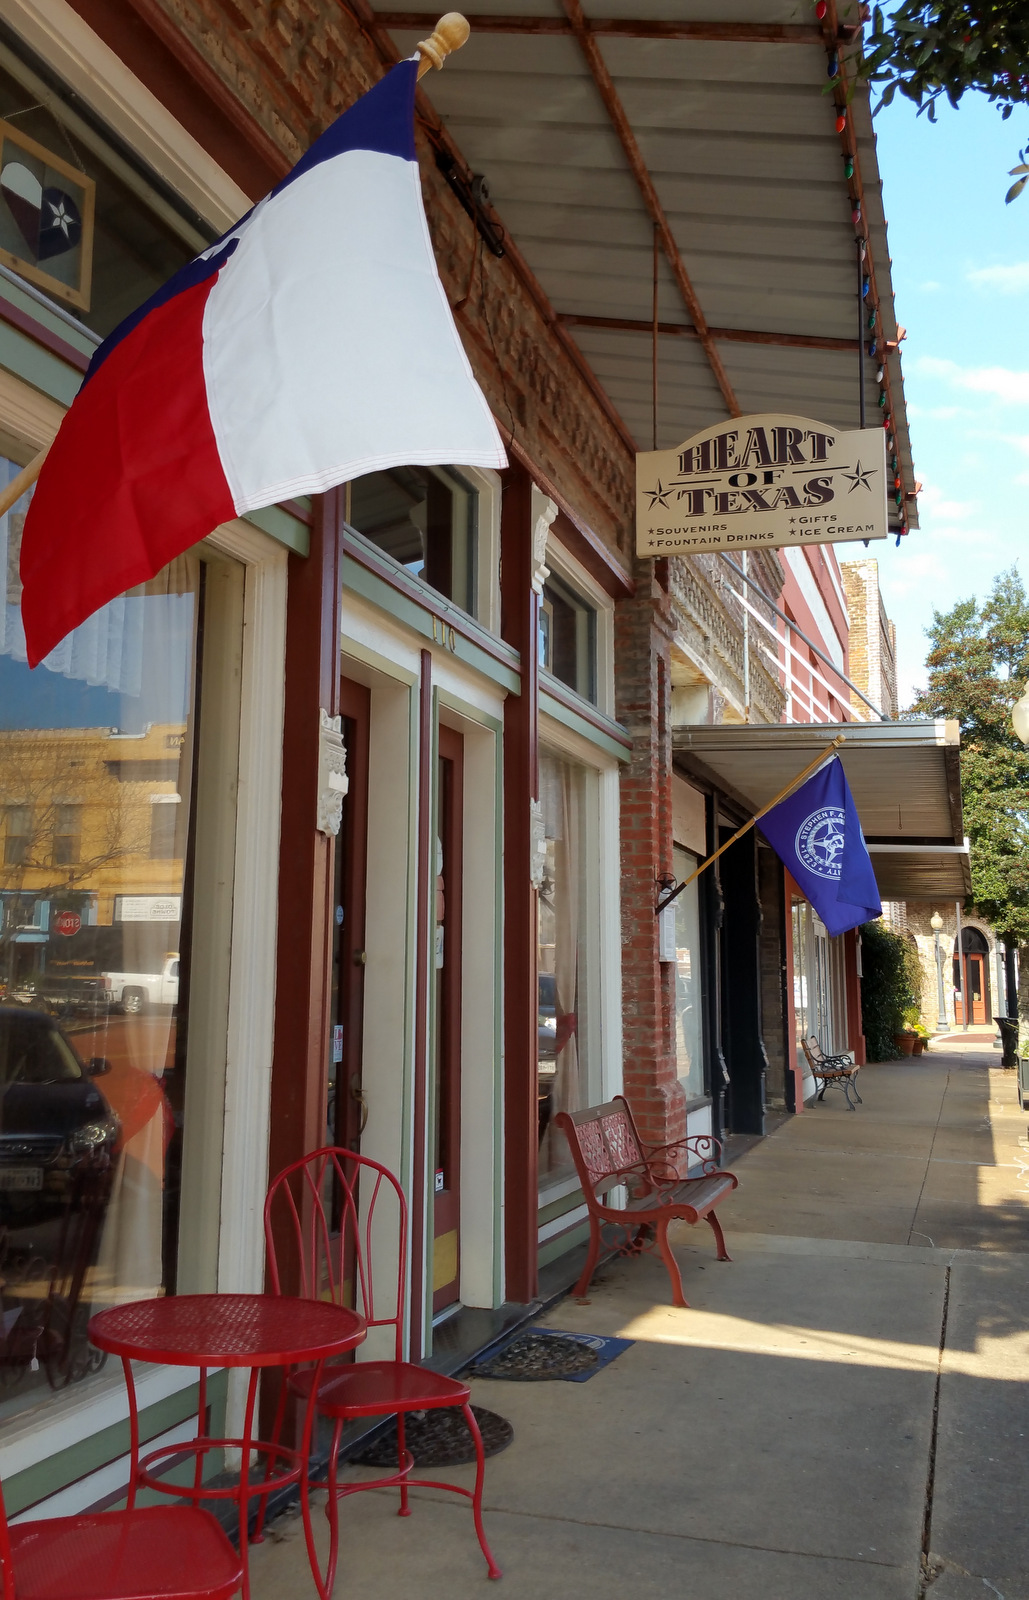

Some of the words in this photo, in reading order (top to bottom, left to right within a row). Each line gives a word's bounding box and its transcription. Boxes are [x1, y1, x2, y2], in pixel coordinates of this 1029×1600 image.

[677, 426, 835, 476] HEART
[728, 469, 784, 487] OF
[677, 476, 835, 517] TEXAS
[799, 515, 837, 524] GIFTS
[656, 524, 728, 535] SOUVENIRS
[800, 528, 821, 537] ICE
[827, 524, 874, 534] CREAM
[656, 536, 721, 547] FOUNTAIN
[726, 532, 775, 542] DRINKS
[432, 615, 456, 654] 110
[801, 811, 828, 840] STEPHEN
[801, 849, 818, 868] 1923
